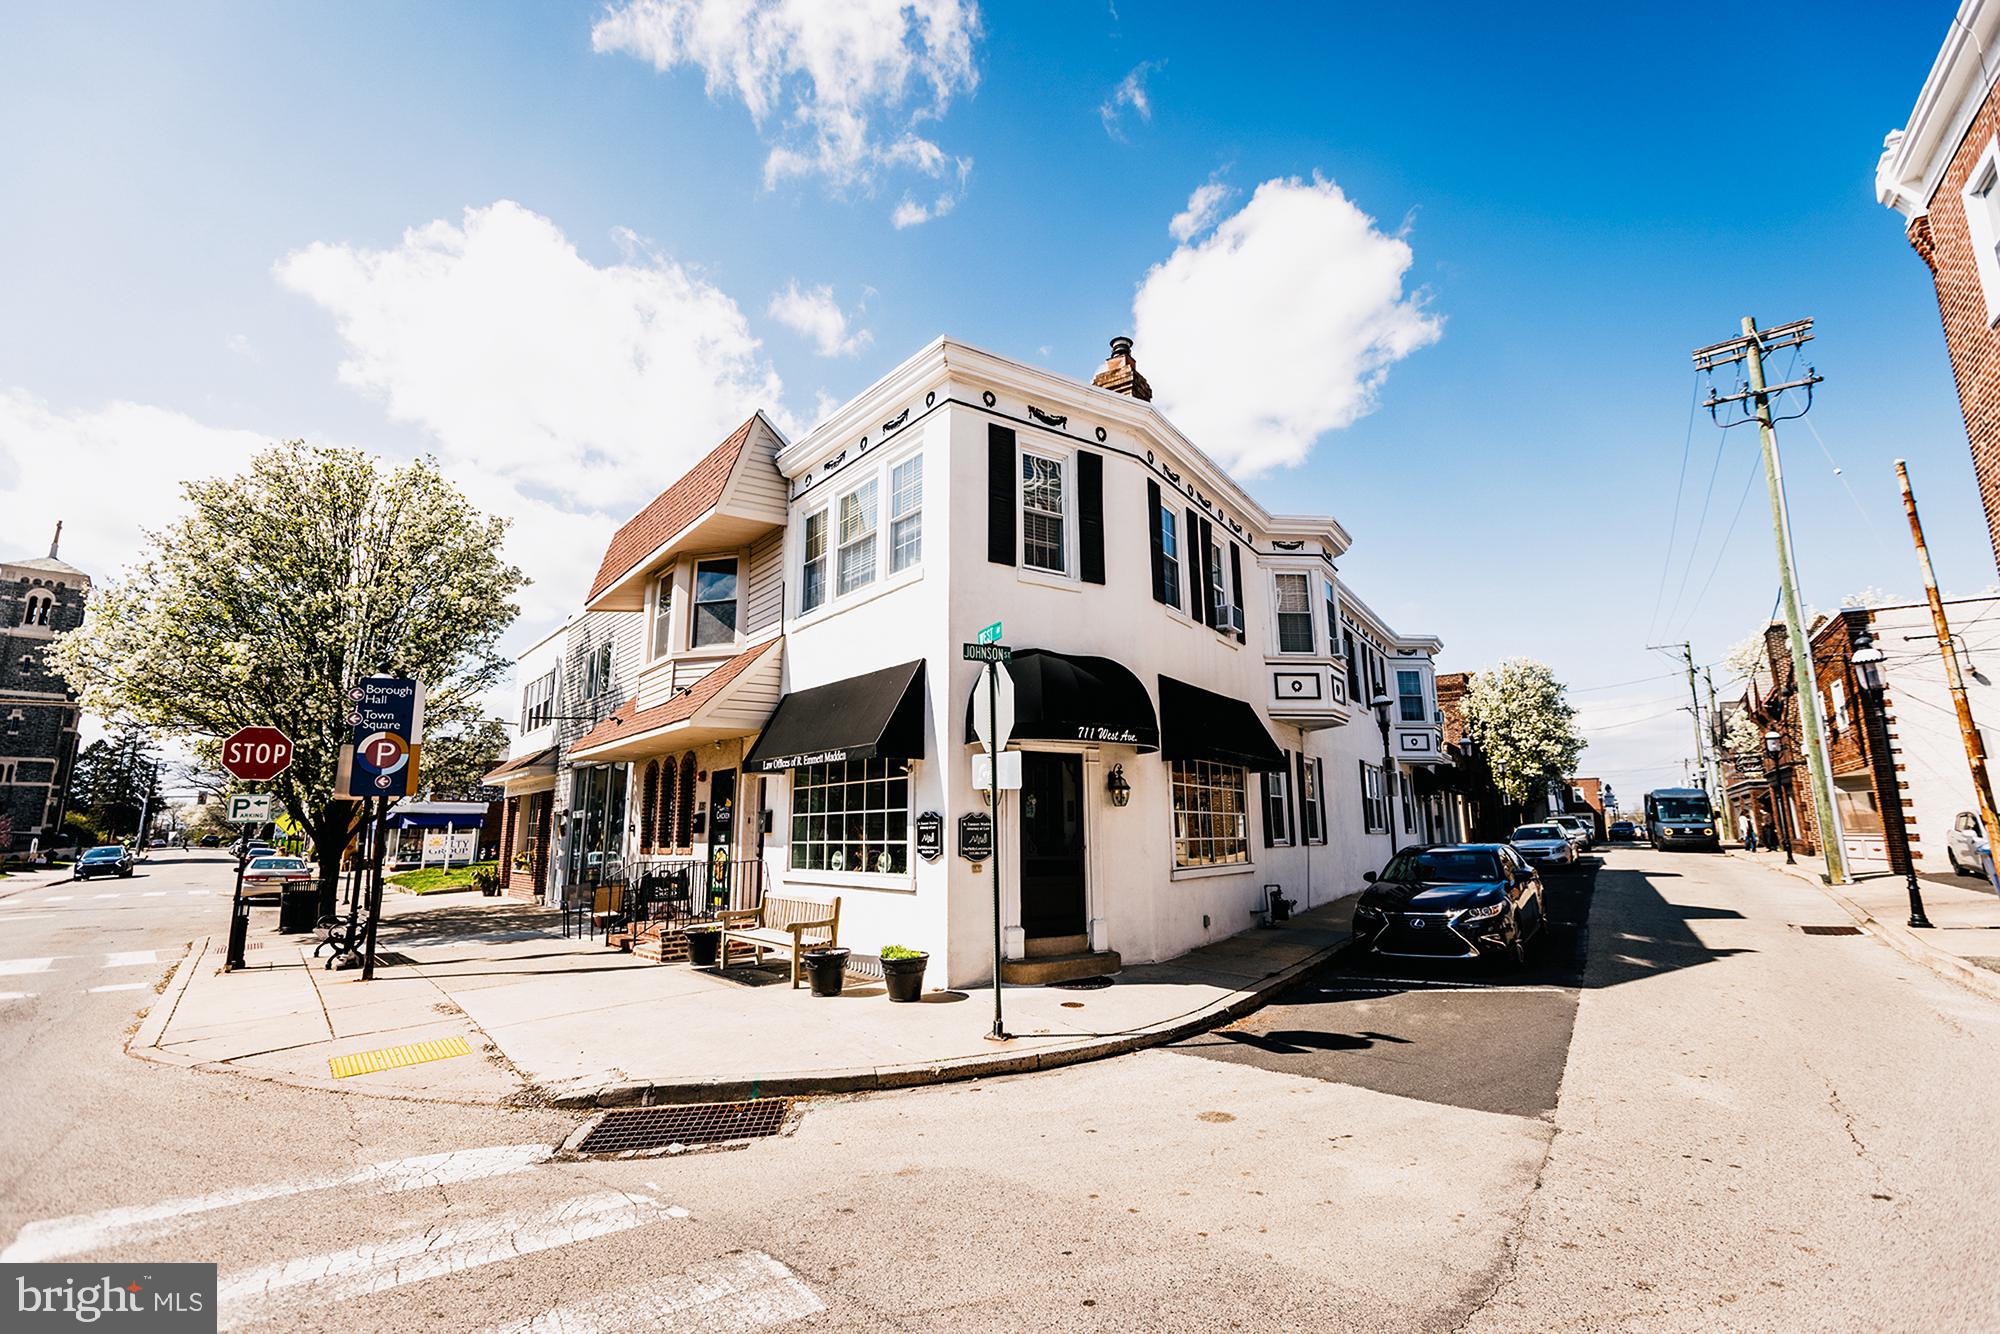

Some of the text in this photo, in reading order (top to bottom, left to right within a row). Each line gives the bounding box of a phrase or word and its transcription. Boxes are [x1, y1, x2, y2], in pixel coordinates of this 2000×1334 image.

[964, 645, 1003, 660] JOHNSON
[366, 685, 413, 698] Borough
[365, 695, 388, 704] Hall
[364, 709, 394, 720] Town
[362, 720, 401, 731] Square
[1078, 726, 1138, 742] 711 West Ave.
[229, 742, 286, 764] STOP
[376, 742, 396, 766] P
[763, 760, 773, 770] Law
[773, 758, 790, 769] Offices
[791, 755, 798, 767] of
[803, 754, 824, 765] Emmett
[824, 750, 847, 762] Madden
